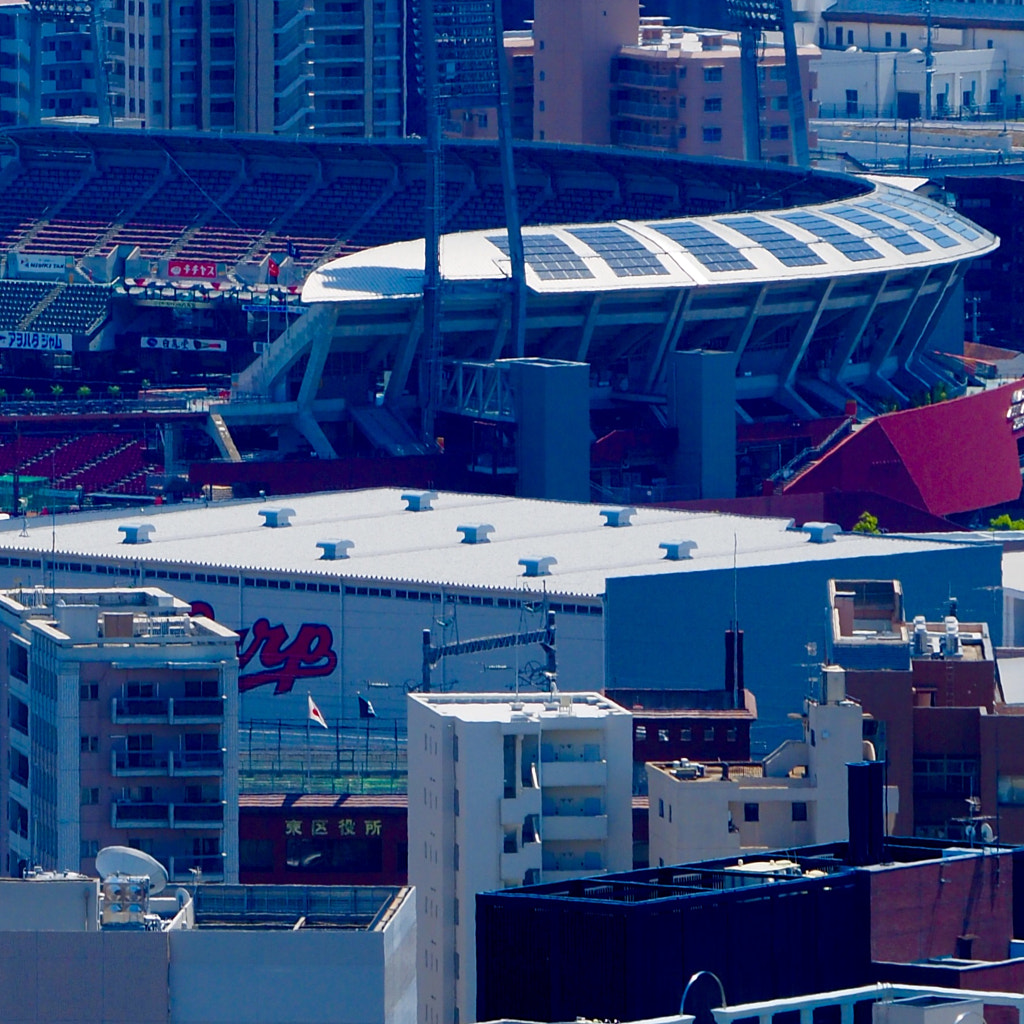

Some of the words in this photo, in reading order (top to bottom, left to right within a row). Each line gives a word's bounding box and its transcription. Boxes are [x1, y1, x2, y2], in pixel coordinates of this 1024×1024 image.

[183, 264, 215, 276] チチヤス
[285, 819, 382, 836] 東区役所
